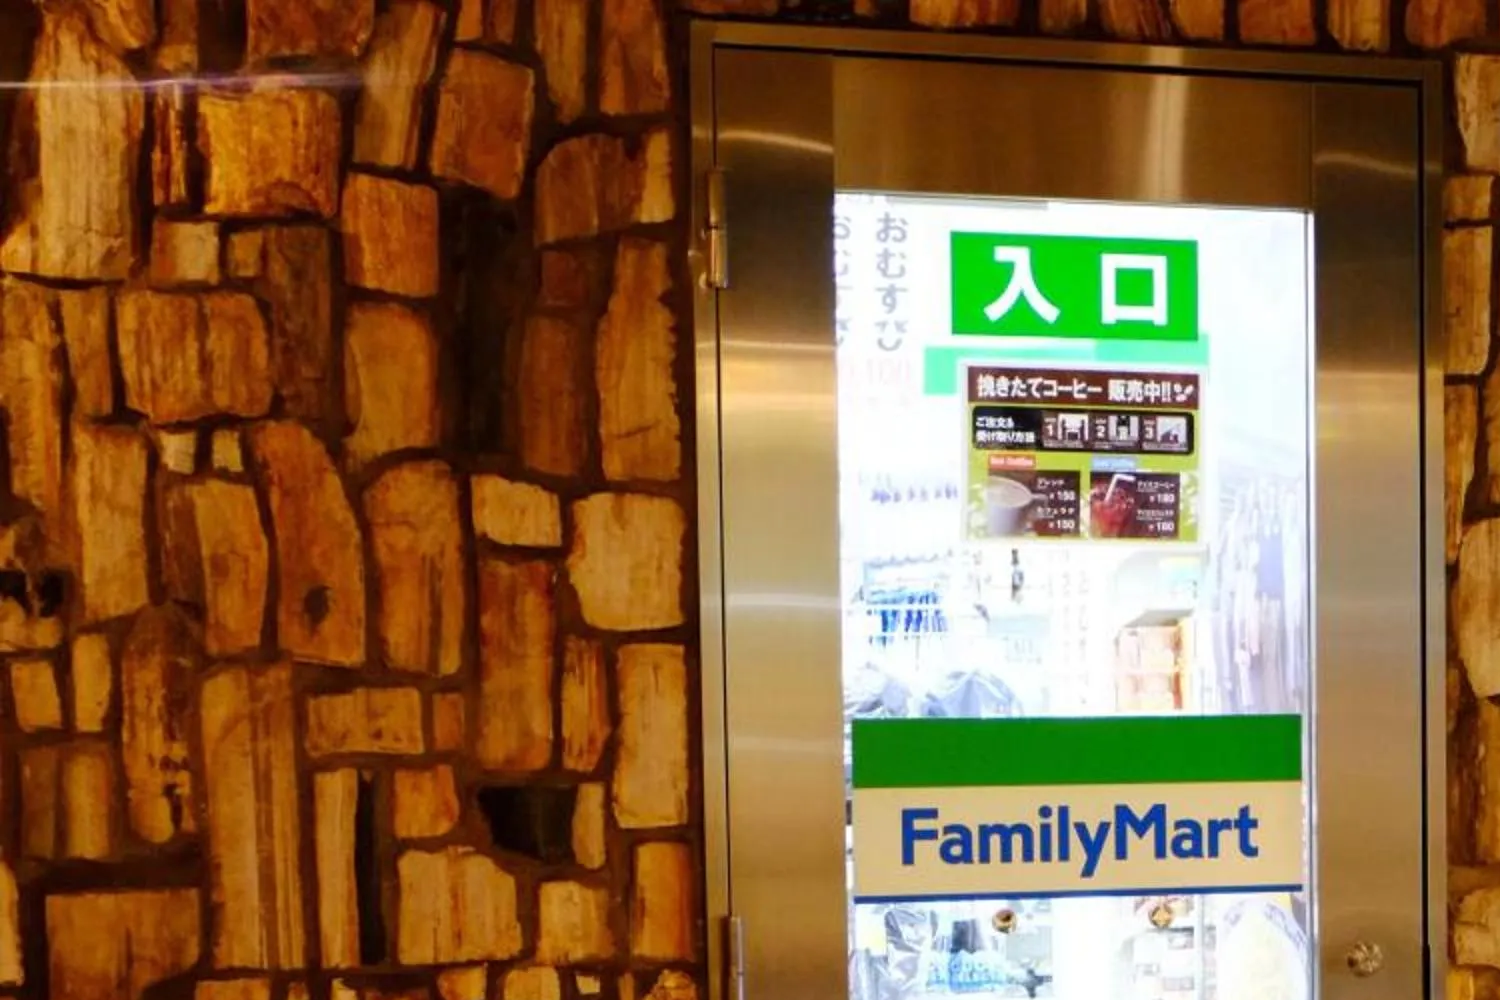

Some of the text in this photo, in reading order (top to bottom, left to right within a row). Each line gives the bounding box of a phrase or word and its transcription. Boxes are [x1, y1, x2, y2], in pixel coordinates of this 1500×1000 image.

[875, 212, 908, 351] おむすび
[984, 246, 1168, 326] 入口
[977, 374, 1103, 399] 挽きたてコーヒー
[901, 804, 1259, 878] FamilyMart
